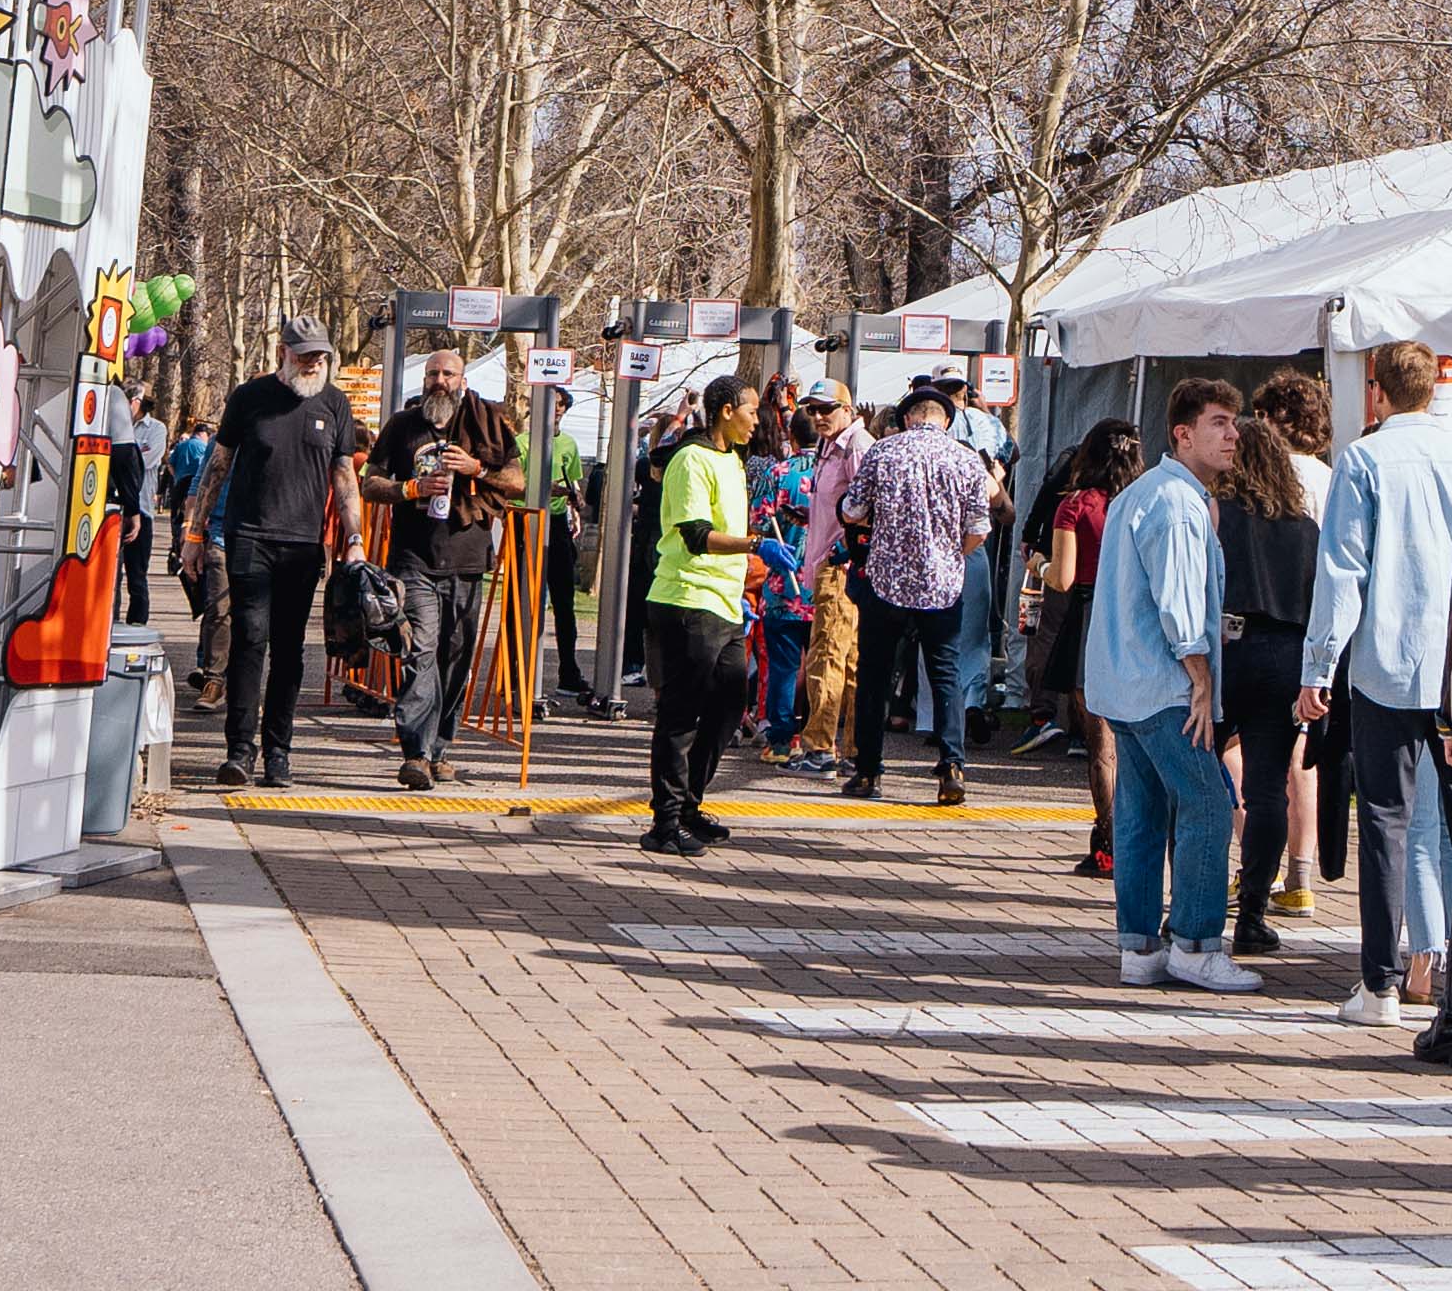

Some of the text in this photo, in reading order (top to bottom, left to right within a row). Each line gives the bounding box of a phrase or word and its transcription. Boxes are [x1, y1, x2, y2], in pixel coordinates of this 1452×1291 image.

[533, 357, 567, 367] NO BAGS
[630, 351, 650, 363] BAGS
